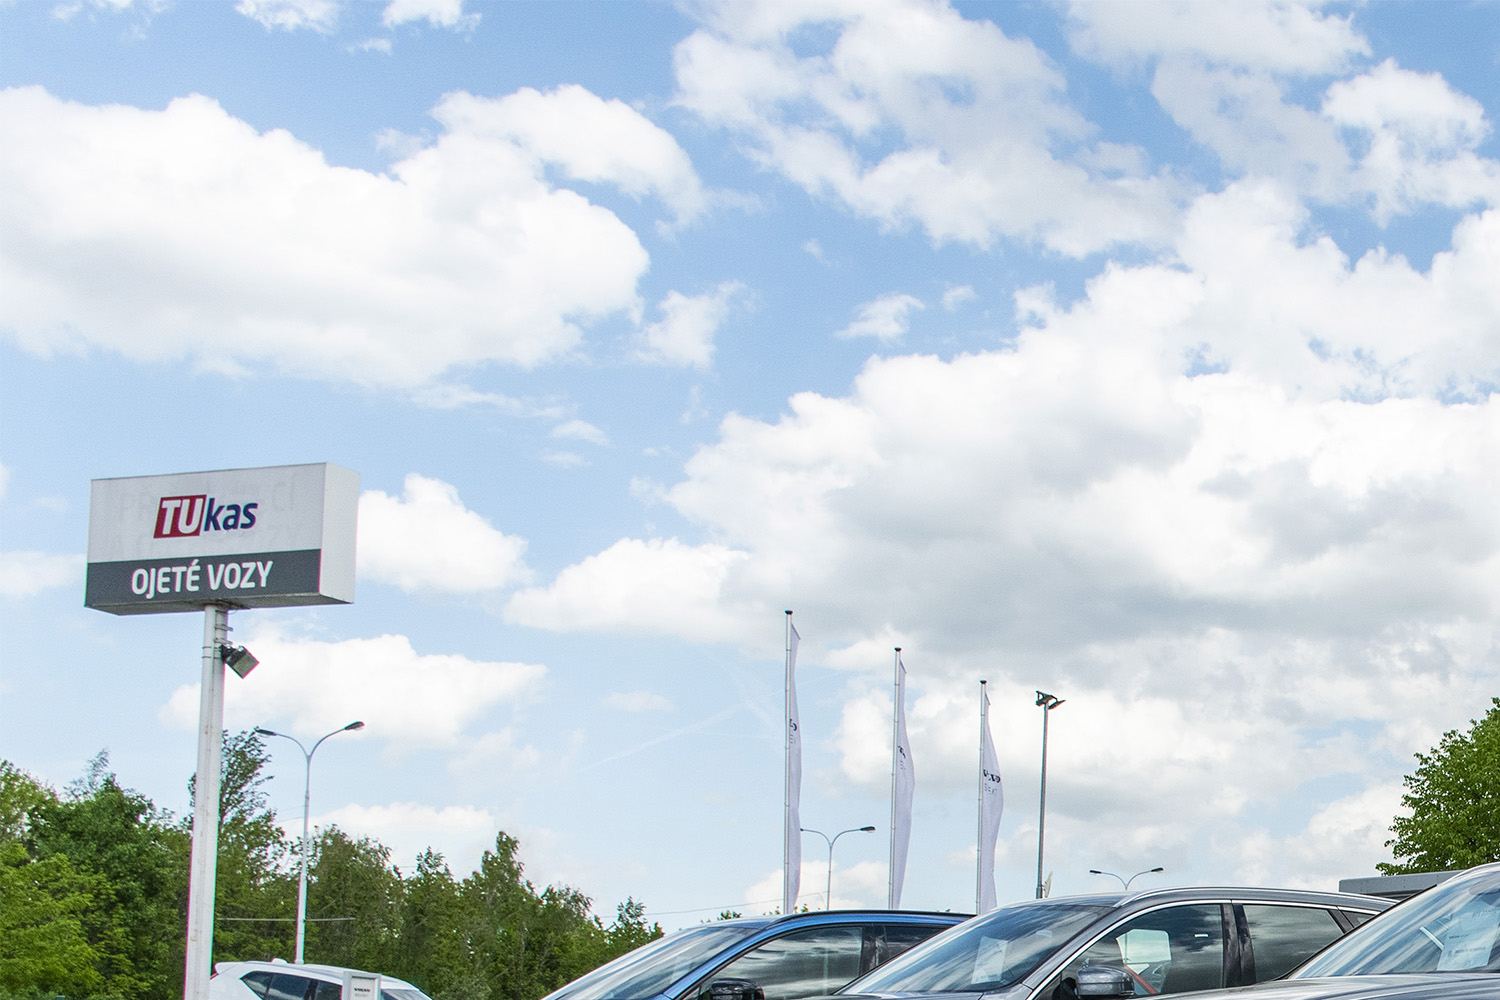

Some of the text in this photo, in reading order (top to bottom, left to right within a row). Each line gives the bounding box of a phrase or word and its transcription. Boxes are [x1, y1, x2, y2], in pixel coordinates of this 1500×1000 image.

[160, 497, 259, 536] TUkas
[131, 559, 273, 599] OJETÉ VOZY
